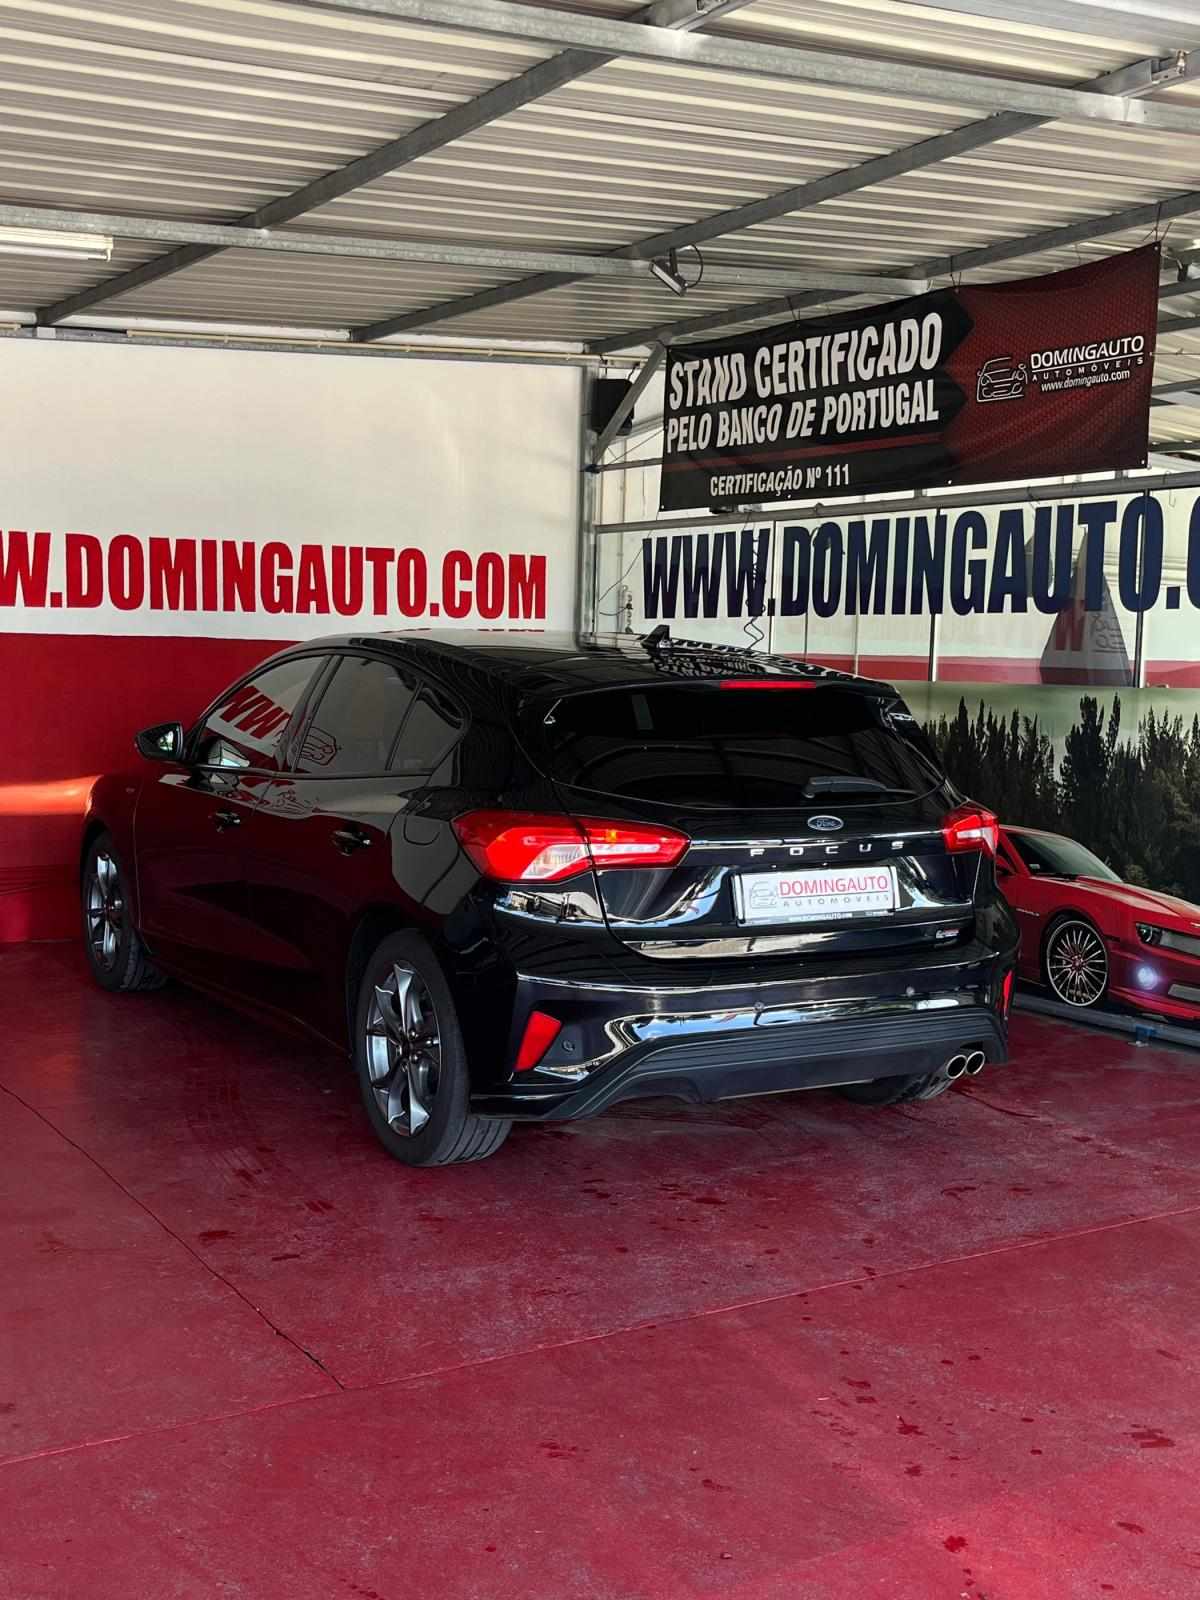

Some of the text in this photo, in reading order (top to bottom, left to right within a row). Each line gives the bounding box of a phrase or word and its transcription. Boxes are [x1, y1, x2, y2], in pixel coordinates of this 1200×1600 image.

[669, 312, 943, 410] STAND CERTIFICADO
[1030, 335, 1145, 369] DOMINGAUTO
[1032, 356, 1144, 382] AUTOMÓVEIS
[1041, 369, 1130, 392] www.domingauto.com
[667, 379, 940, 453] PELO BANCO DE PORTUGAL
[710, 465, 803, 497] CERTIFICAÇÃO
[825, 463, 850, 487] 111
[750, 840, 905, 857] FOCUS
[779, 874, 889, 896] DOMINGAUTO
